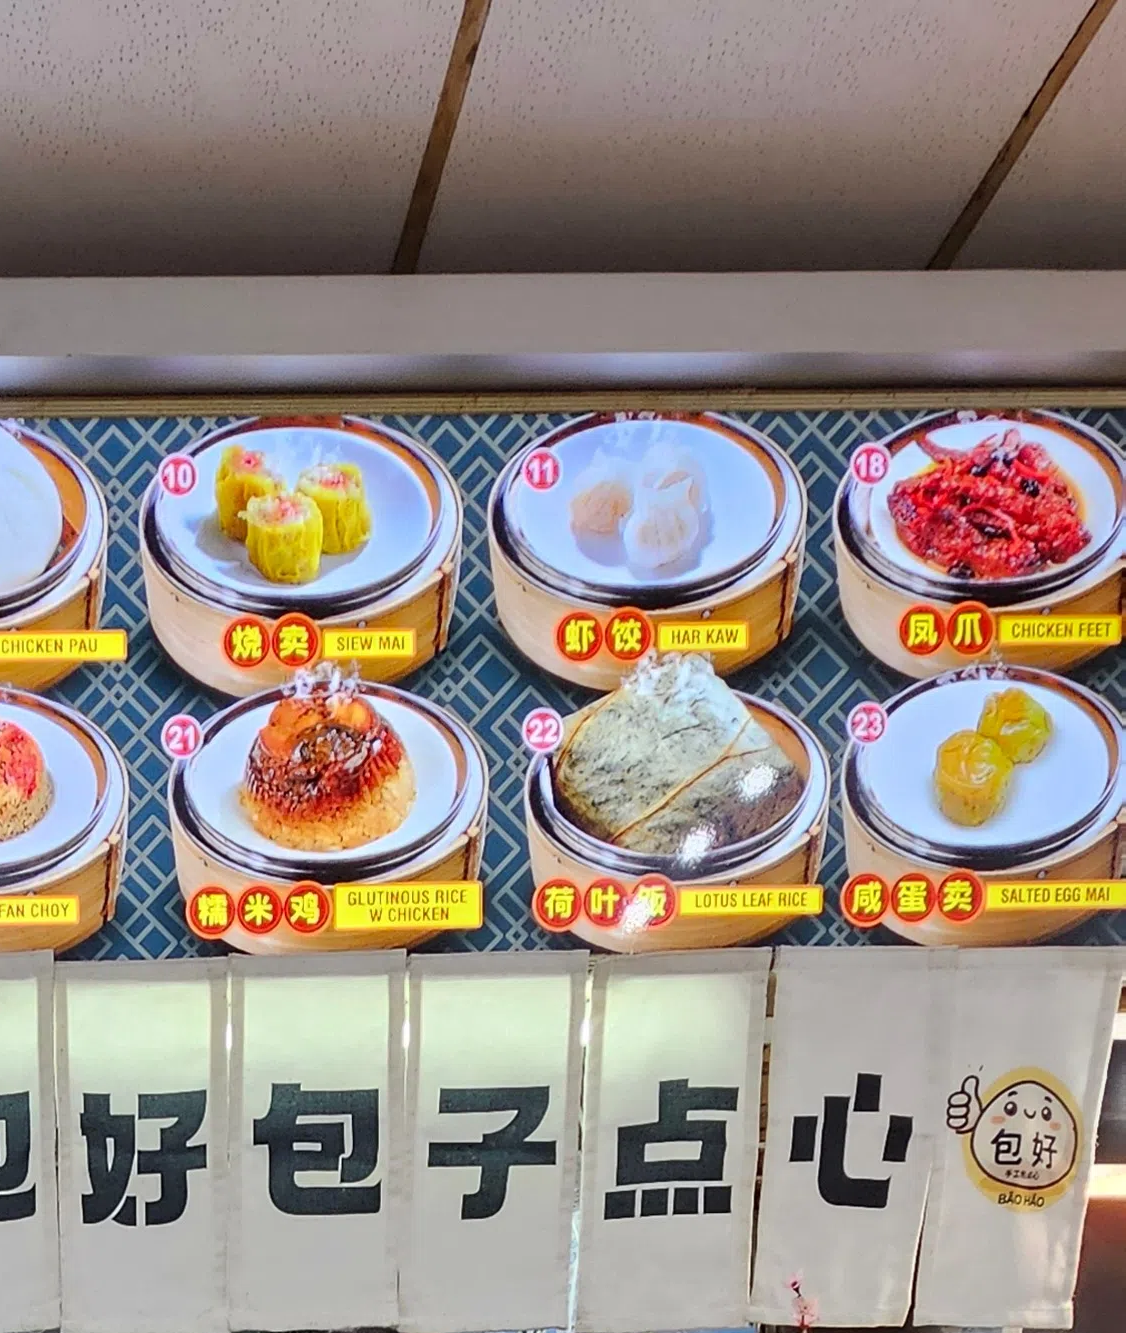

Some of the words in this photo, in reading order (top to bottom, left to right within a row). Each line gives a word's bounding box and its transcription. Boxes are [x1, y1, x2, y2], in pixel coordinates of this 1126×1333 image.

[164, 465, 193, 490] 10
[528, 460, 556, 484] 11
[856, 453, 885, 478] 18
[231, 624, 310, 659] 烧卖
[564, 618, 642, 653] 虾饺
[671, 629, 701, 644] HAR
[706, 628, 739, 644] KAW
[906, 612, 983, 647] 凤爪
[1011, 622, 1074, 638] CHICKEN
[1078, 622, 1112, 638] FEET
[1, 638, 64, 655] CHICKEN
[69, 638, 99, 653] PAU
[336, 636, 373, 652] SIEW
[378, 636, 406, 650] MAI
[528, 718, 559, 742] 22
[851, 712, 884, 737] 23
[168, 726, 196, 750] 21
[347, 890, 430, 906] GLUTINOUS
[435, 889, 468, 904] RICE
[694, 892, 738, 908] LOTUS
[742, 892, 774, 908] LEAF
[778, 891, 808, 907] RICE
[851, 880, 973, 914] 咸蛋卖
[1000, 887, 1050, 904] SALTED
[1055, 887, 1081, 902] EGG
[1085, 886, 1111, 902] MAI
[30, 902, 70, 918] CHOY
[197, 892, 321, 926] 糯米鸡
[369, 908, 383, 922] W
[387, 907, 450, 922] CHICKEN
[990, 1127, 1058, 1169] 包好
